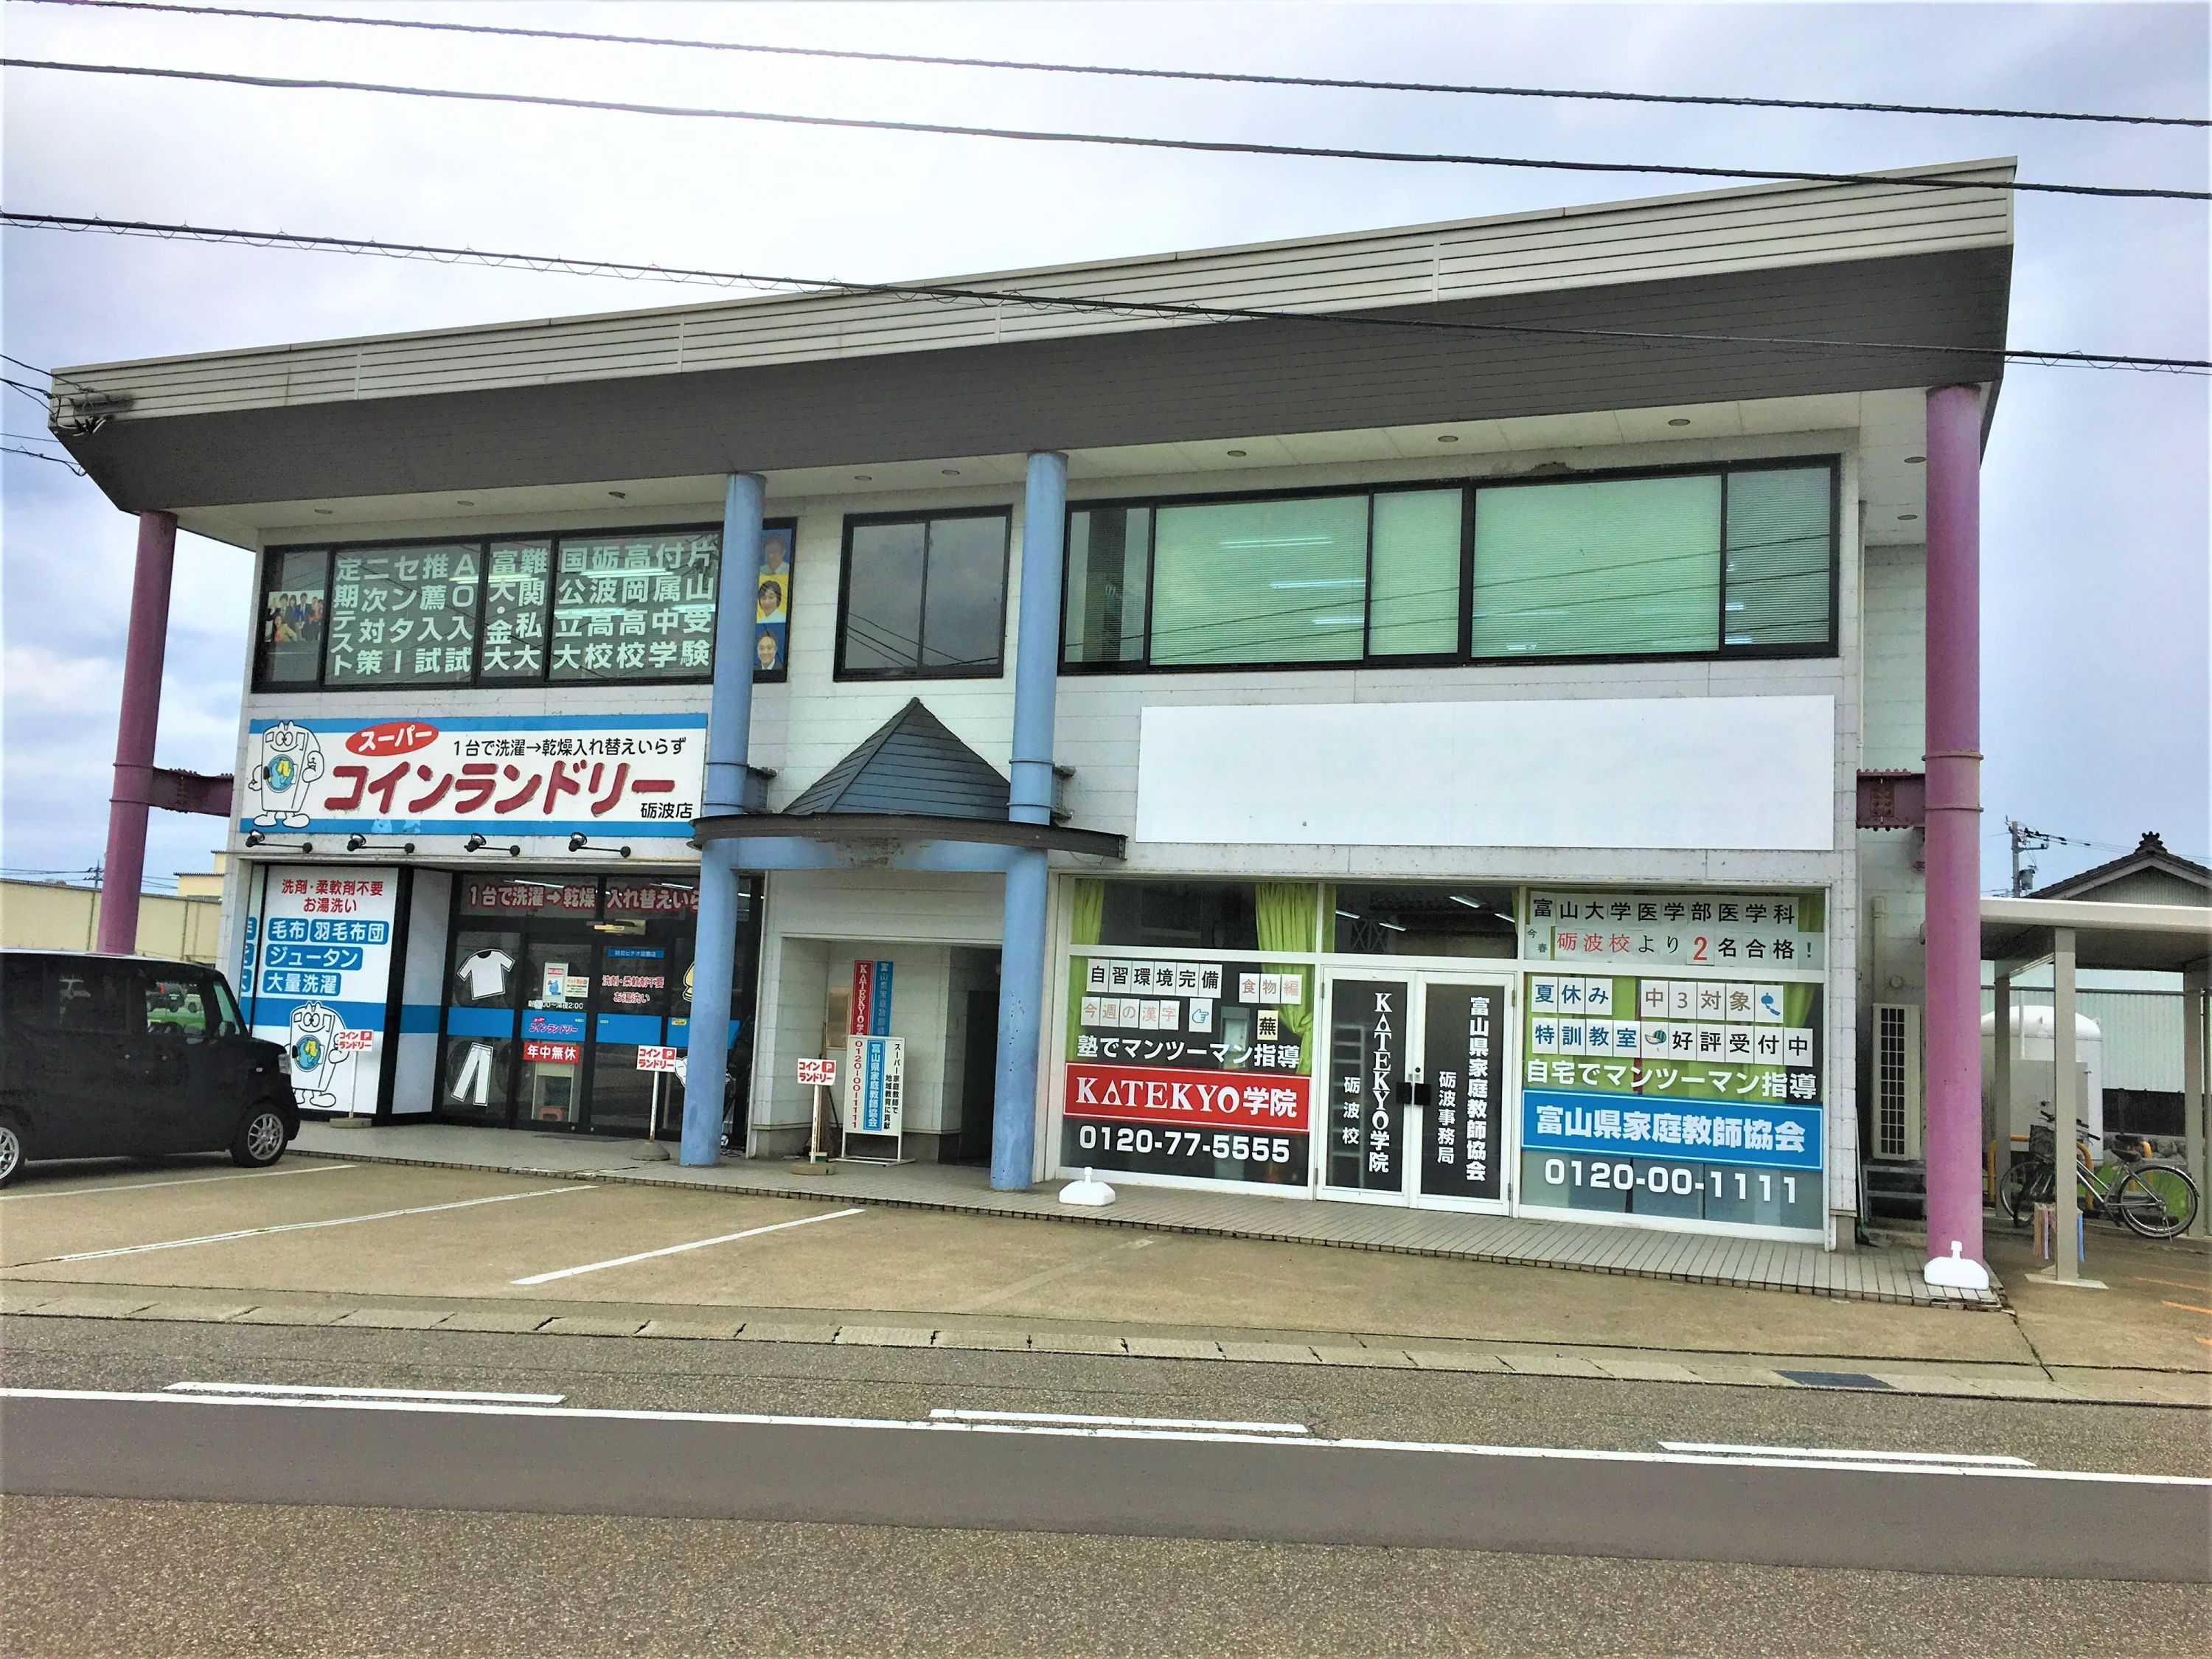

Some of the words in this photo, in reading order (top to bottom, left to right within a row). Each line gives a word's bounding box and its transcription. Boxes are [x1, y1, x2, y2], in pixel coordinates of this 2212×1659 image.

[330, 558, 361, 675] 定期テスト
[356, 558, 389, 675] 二次対策
[389, 555, 418, 673] センター
[415, 553, 448, 673] 推薦入試
[445, 554, 476, 673] AO入試
[484, 550, 518, 671] 富大・金大
[512, 548, 548, 670] 難関私大
[553, 547, 588, 669] 国公立大
[585, 546, 621, 669] 砺波高校
[616, 543, 653, 669] 高岡高校
[648, 542, 684, 669] 付属中学
[358, 723, 433, 753] スーパー
[324, 759, 676, 818] コインランドリー
[641, 801, 693, 820] 砺波店
[282, 879, 384, 897] 洗剤・柔軟剤不要
[303, 897, 358, 914] お湯洗い
[1533, 898, 1795, 925] 富山大学医学部医学科
[271, 921, 305, 940] 毛布
[313, 922, 385, 943] 羽毛布団
[270, 946, 358, 968] ジュータン
[266, 974, 338, 995] 大量洗濯
[1091, 965, 1220, 990] 自習環境完備
[1242, 979, 1300, 997] 食物編
[613, 992, 650, 1004] お湯洗い
[1534, 983, 1609, 1004] 夏休み
[1644, 987, 1752, 1012] 中3対象
[1083, 1004, 1177, 1023] 今週の漢字
[1259, 1017, 1276, 1036] 蕪
[339, 1032, 358, 1040] コイン
[339, 1041, 372, 1049] ランドリー
[1077, 1034, 1301, 1068] 塾でマンツーマン指導
[1535, 1025, 1638, 1048] 特訓教室
[1672, 1030, 1809, 1057] 好評受付中
[527, 1044, 576, 1061] 年中無休
[639, 1048, 661, 1058] コイン
[639, 1060, 675, 1069] ランドリー
[799, 1060, 821, 1071] コイン
[799, 1072, 833, 1082] ランドリー
[852, 1040, 863, 1129] 0120-00-1111
[1368, 992, 1392, 1173] KATEKYO学院
[1466, 996, 1490, 1182] 富山県家庭教師協会
[1526, 1059, 1818, 1099] 自宅でマンツーマン指導
[1076, 1076, 1298, 1118] KATEKYO学院
[1342, 1077, 1360, 1145] 砺波校
[1437, 1071, 1457, 1165] 砺波事務局
[1536, 1105, 1806, 1153] 富山県家庭教師協会
[1079, 1125, 1290, 1164] 0120-77-5555
[1545, 1158, 1797, 1204] 0120-00-1111
